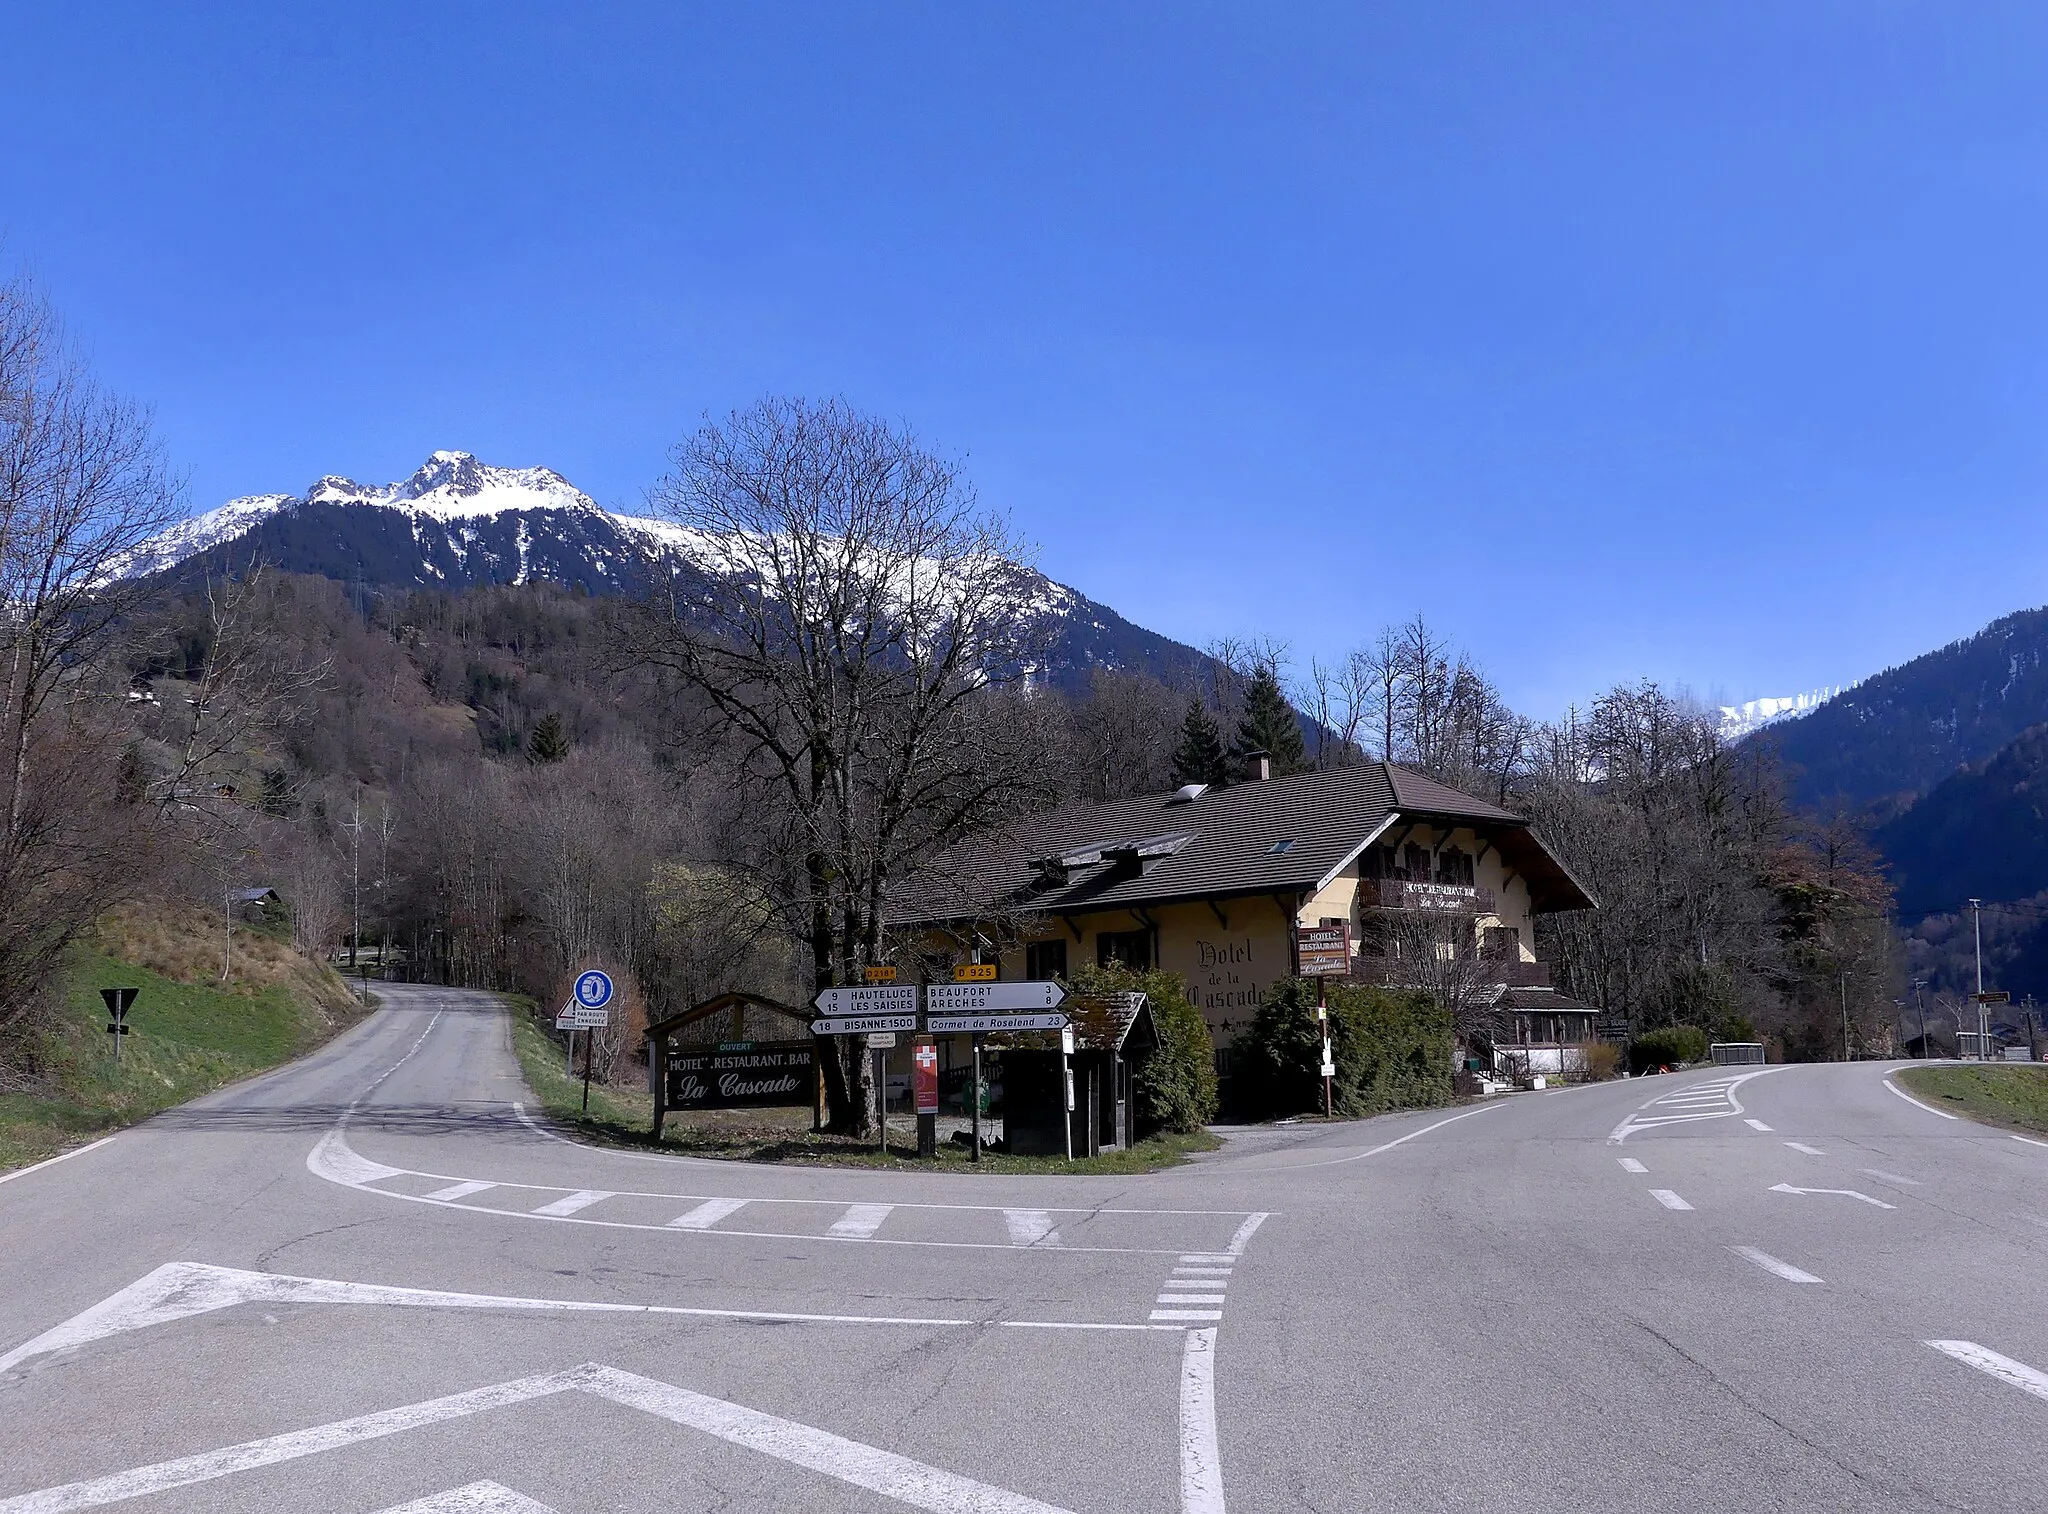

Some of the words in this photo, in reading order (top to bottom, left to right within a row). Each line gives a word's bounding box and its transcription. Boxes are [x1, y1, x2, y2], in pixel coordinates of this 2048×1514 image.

[1310, 932, 1332, 940] HOTEL
[1300, 941, 1345, 951] RESTAURANT
[959, 968, 965, 977] D
[970, 968, 992, 977] 925
[1208, 972, 1221, 986] de
[1227, 971, 1240, 984] la
[832, 992, 838, 1001] 9
[851, 989, 913, 1000] HAUTELUCE
[930, 987, 992, 997] BEAUFORT
[1045, 985, 1051, 994] 3
[827, 1003, 838, 1012] 15
[851, 1002, 869, 1011] LES
[873, 1000, 913, 1010] SAISIES
[931, 998, 985, 1008] ARECHES
[1045, 996, 1052, 1005] 8
[819, 1022, 831, 1031] 18
[844, 1020, 887, 1030] BISANNE
[889, 1018, 913, 1028] 1500
[931, 1020, 967, 1029] Cormet
[973, 1019, 985, 1028] de
[990, 1017, 1035, 1028] Roselend
[1047, 1017, 1060, 1026] 23
[720, 1042, 752, 1051] OUVERT
[670, 1058, 703, 1071] HOTEL
[789, 1053, 811, 1065] BAR
[677, 1075, 709, 1100] La
[718, 1072, 801, 1097] Cascade
